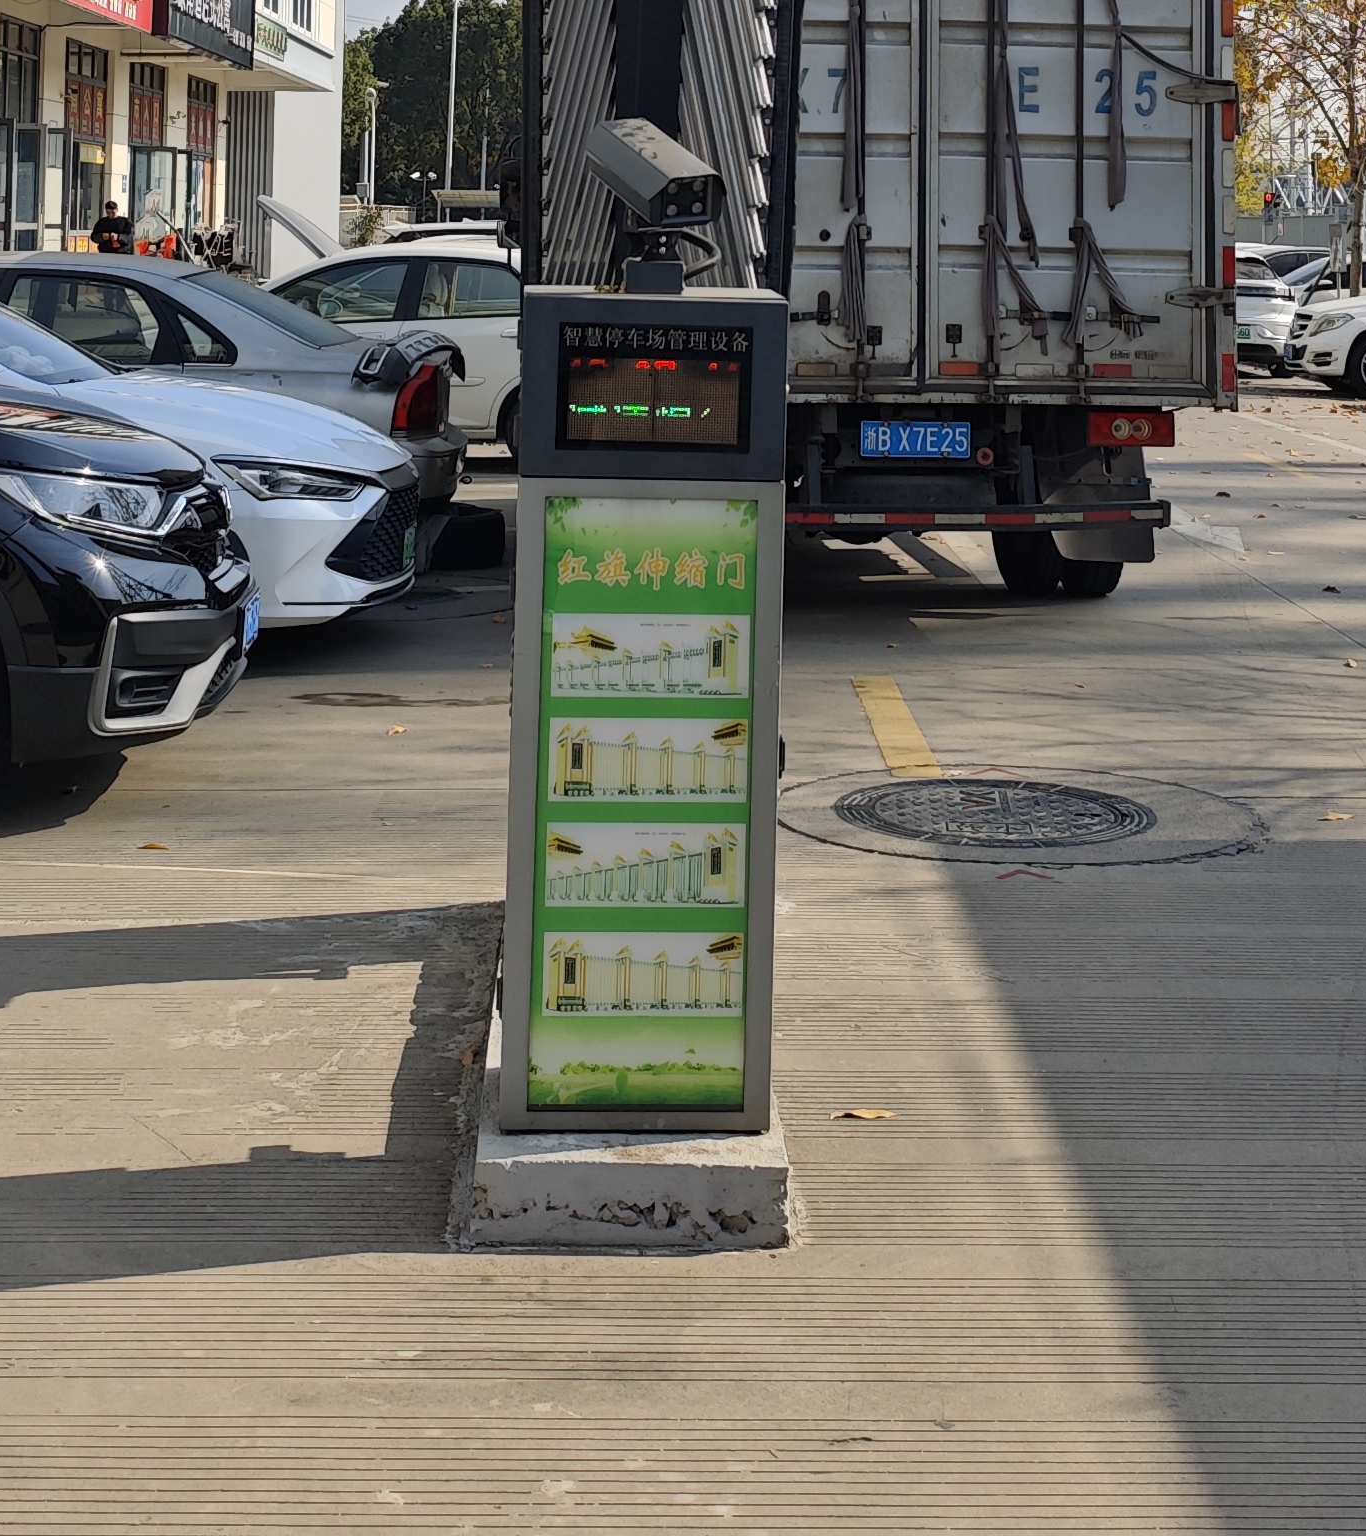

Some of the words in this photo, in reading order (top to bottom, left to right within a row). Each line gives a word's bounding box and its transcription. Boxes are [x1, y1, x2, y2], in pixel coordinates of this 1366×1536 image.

[1017, 65, 1040, 114] E
[1094, 67, 1158, 118] 25
[562, 325, 750, 353] 智慧停车场管理设备
[557, 547, 746, 590] 红旗伸缩门
